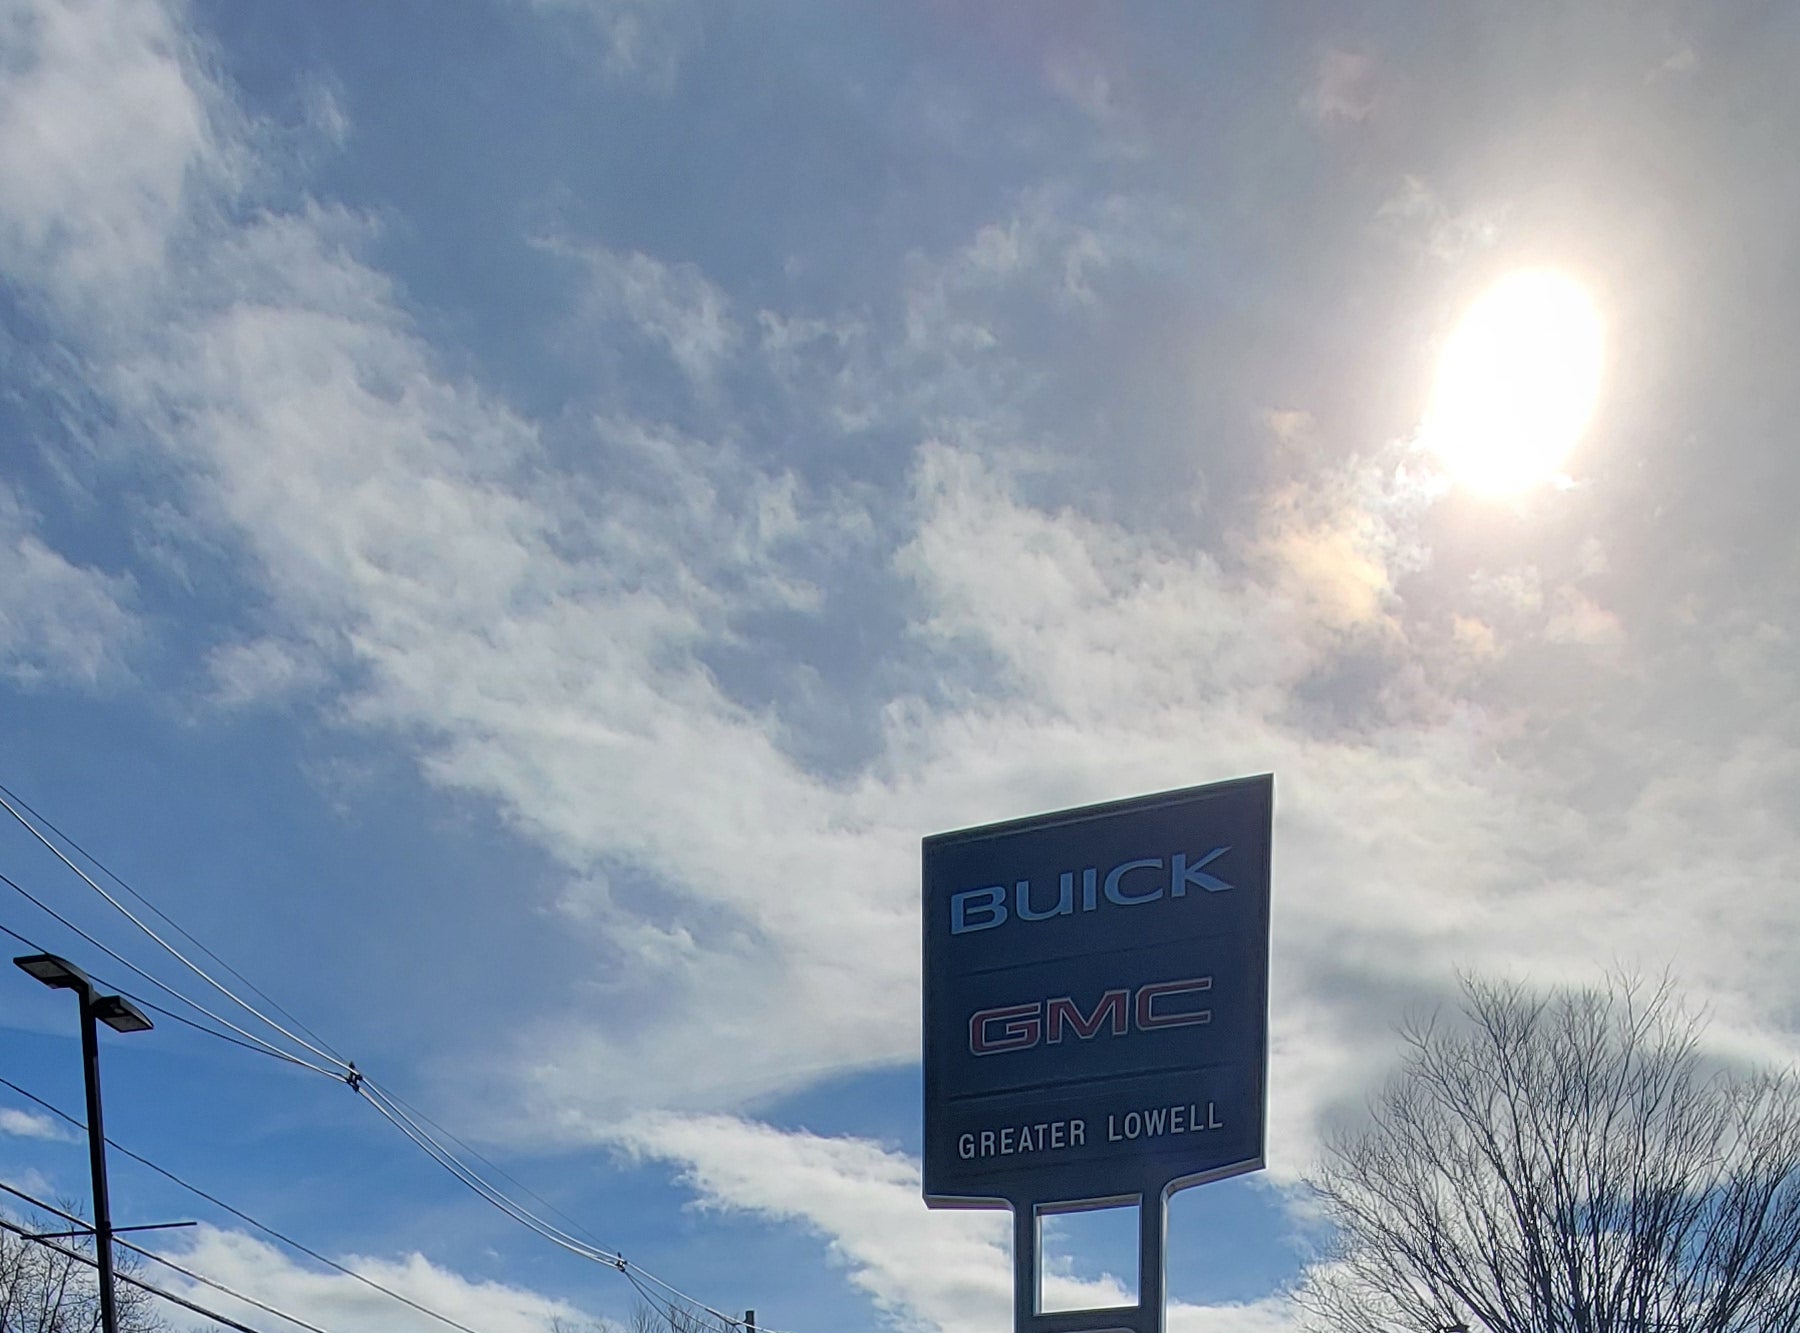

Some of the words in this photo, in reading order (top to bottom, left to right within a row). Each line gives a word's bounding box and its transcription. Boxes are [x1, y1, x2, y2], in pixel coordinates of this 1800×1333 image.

[950, 846, 1235, 935] BUICK
[969, 976, 1212, 1056] GMC
[958, 1120, 1086, 1159] GREATER
[1108, 1102, 1223, 1142] LOWELL
